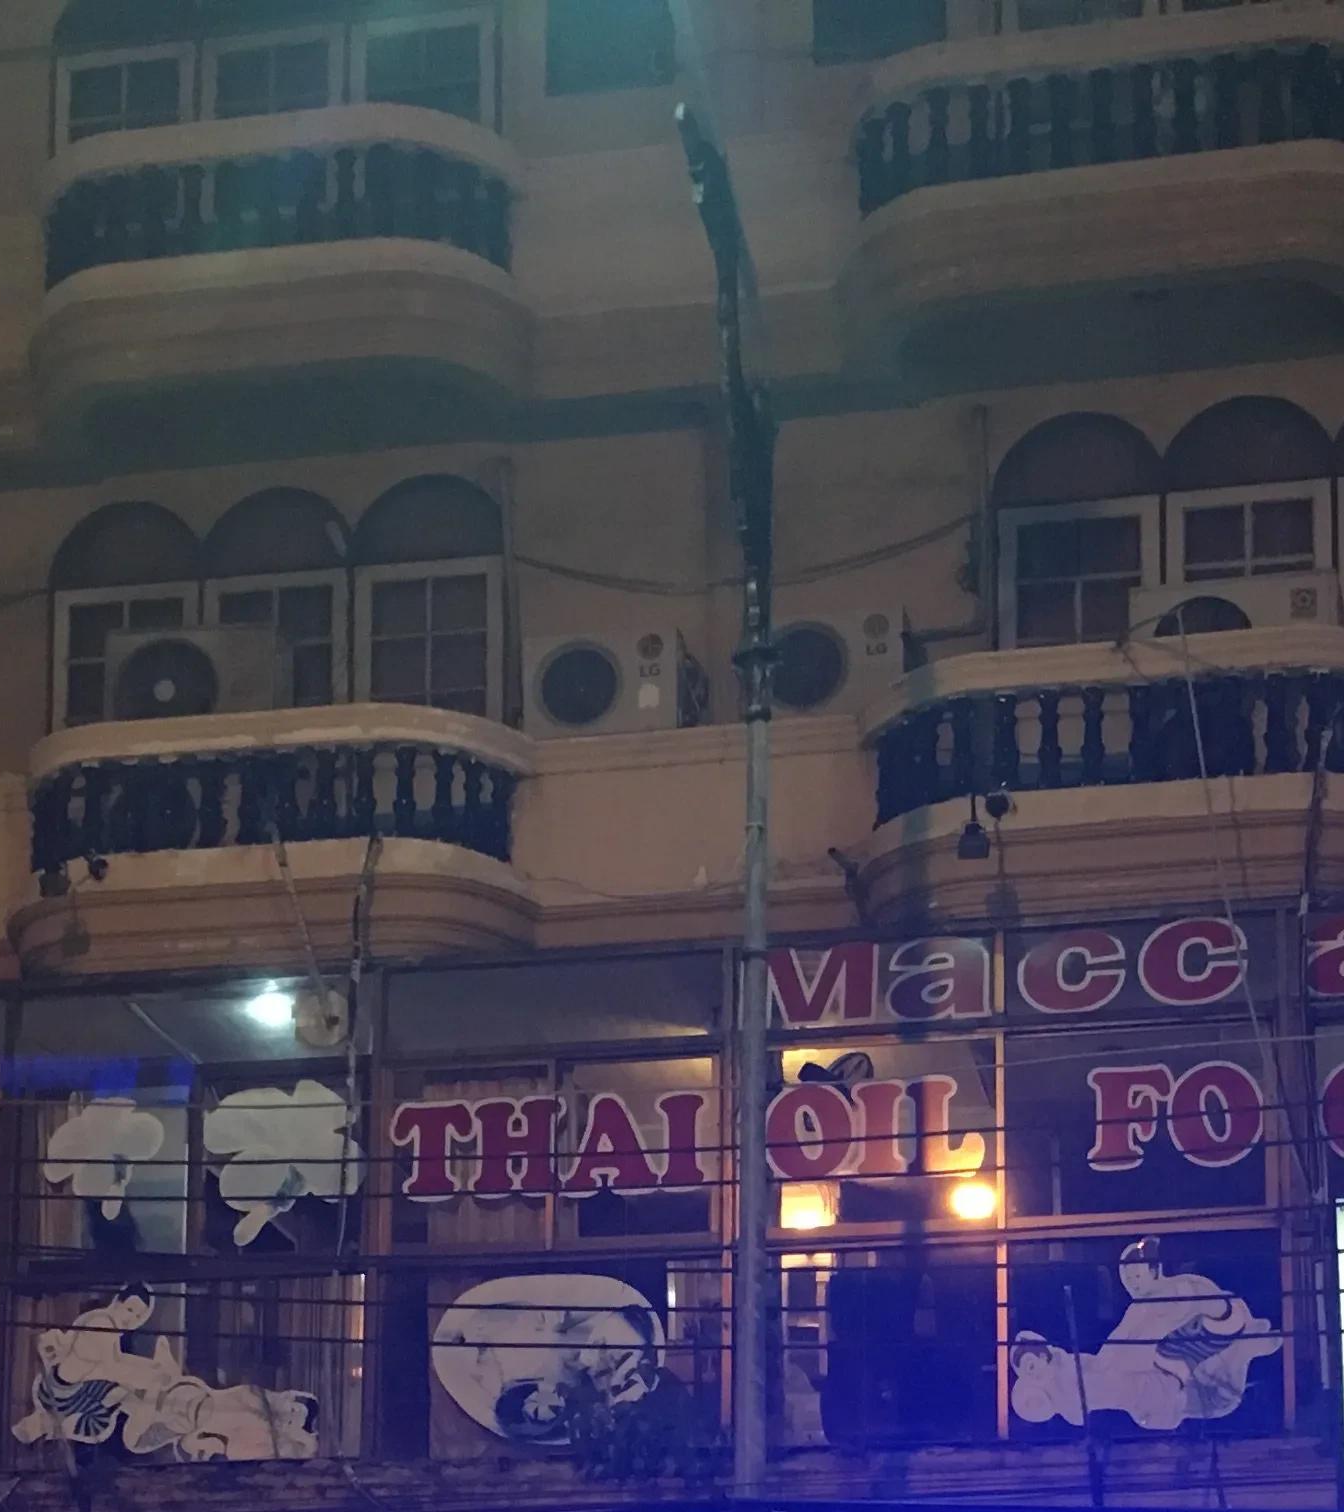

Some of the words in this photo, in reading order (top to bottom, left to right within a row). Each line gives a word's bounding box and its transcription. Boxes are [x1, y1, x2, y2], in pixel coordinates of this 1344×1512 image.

[866, 643, 887, 656] LG
[639, 664, 661, 677] LG
[390, 1090, 714, 1204] THAI
[767, 1074, 986, 1180] OIL
